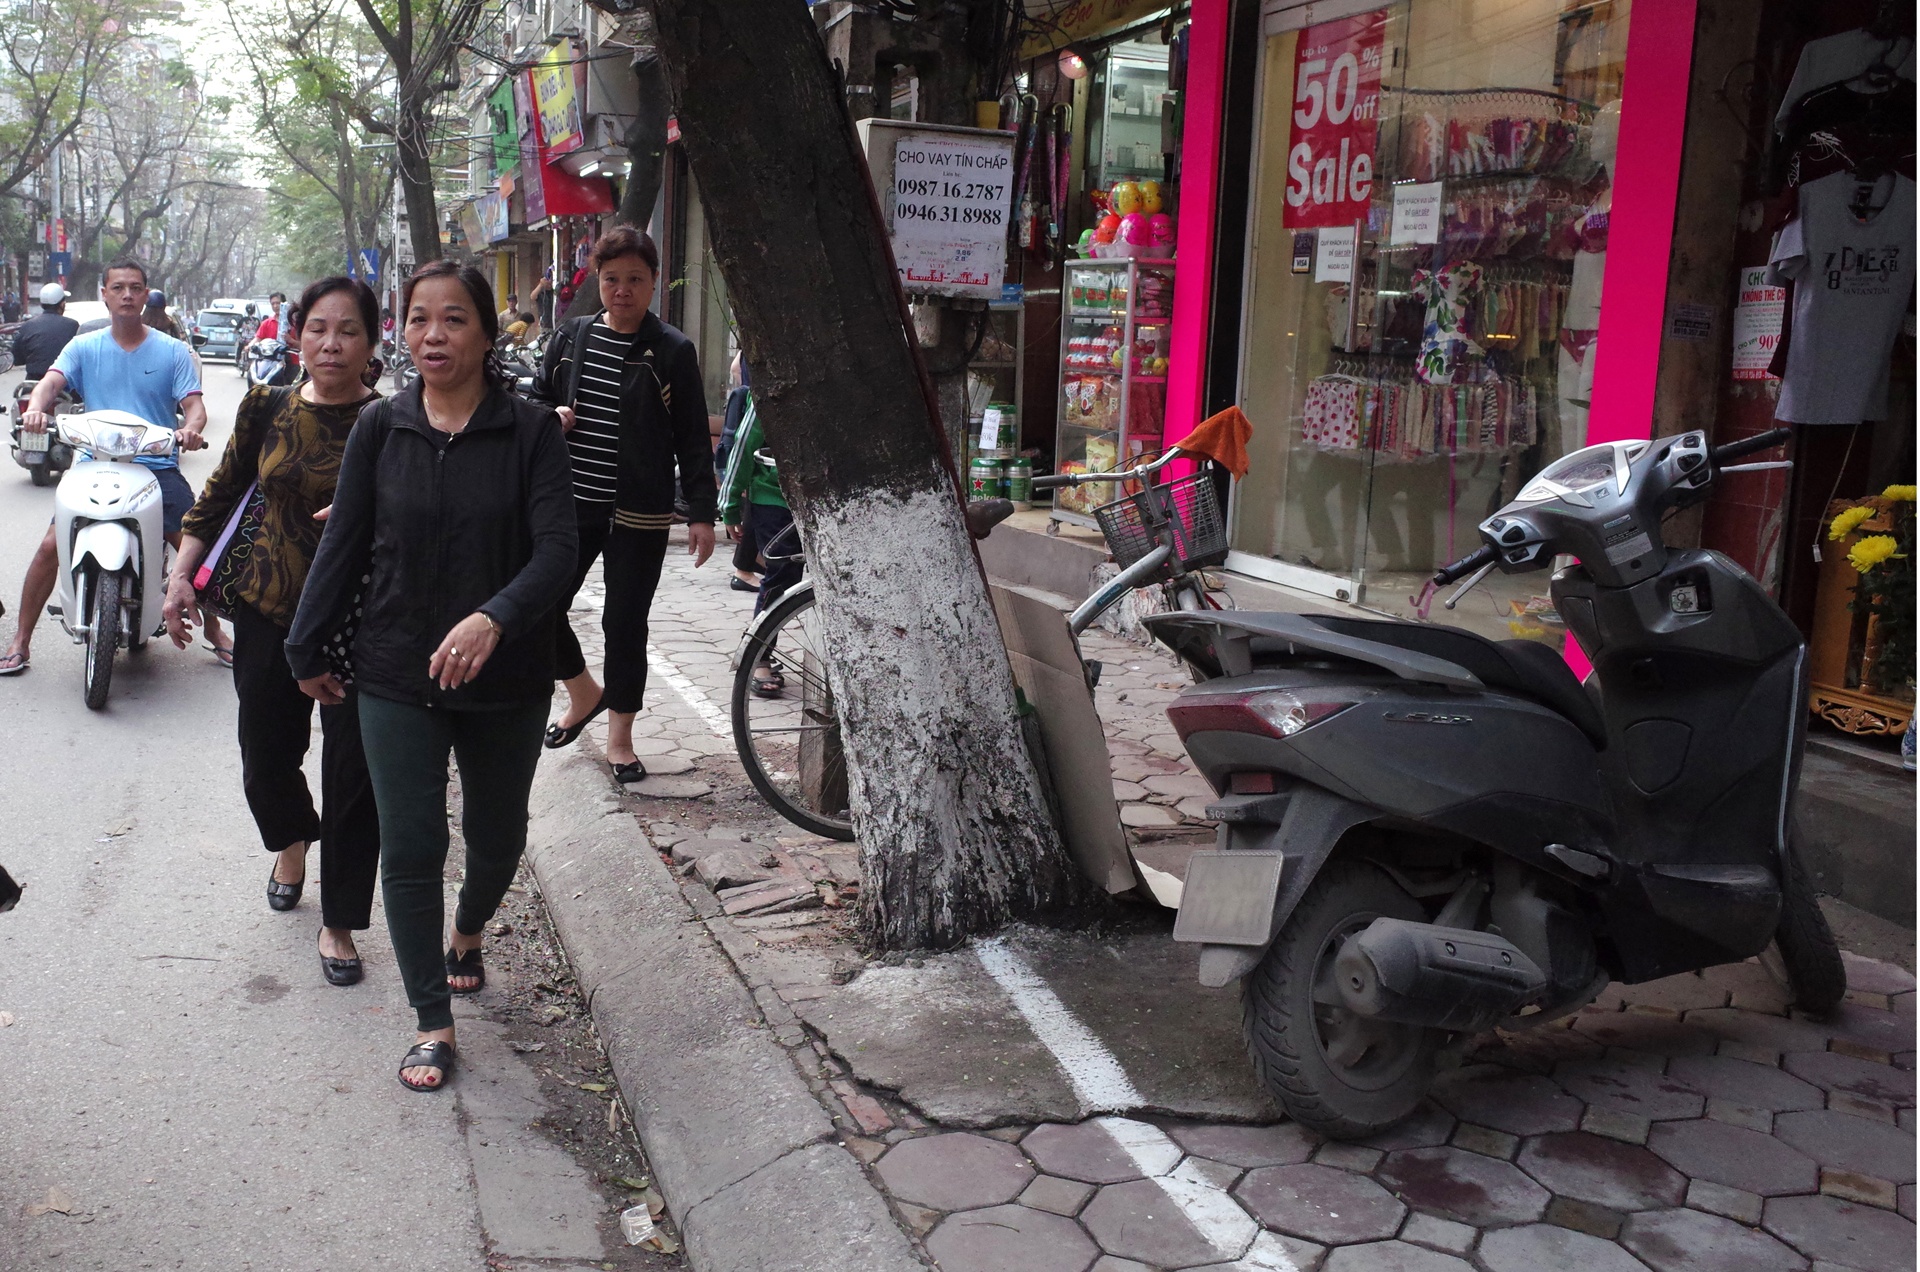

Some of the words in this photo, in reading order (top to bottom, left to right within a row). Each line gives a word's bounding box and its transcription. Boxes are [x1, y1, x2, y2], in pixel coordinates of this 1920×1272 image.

[1301, 47, 1315, 58] up
[1316, 44, 1328, 54] to
[1294, 52, 1359, 130] 50
[1362, 47, 1380, 69] %
[1353, 95, 1377, 122] off
[898, 150, 925, 165] CHO
[928, 152, 952, 166] VAY
[955, 152, 973, 168] TÍN
[975, 153, 1008, 170] CHẤP
[1286, 137, 1372, 208] Sale
[897, 178, 1005, 201] 0987.16.2787
[897, 202, 1002, 226] 0946.31.8988
